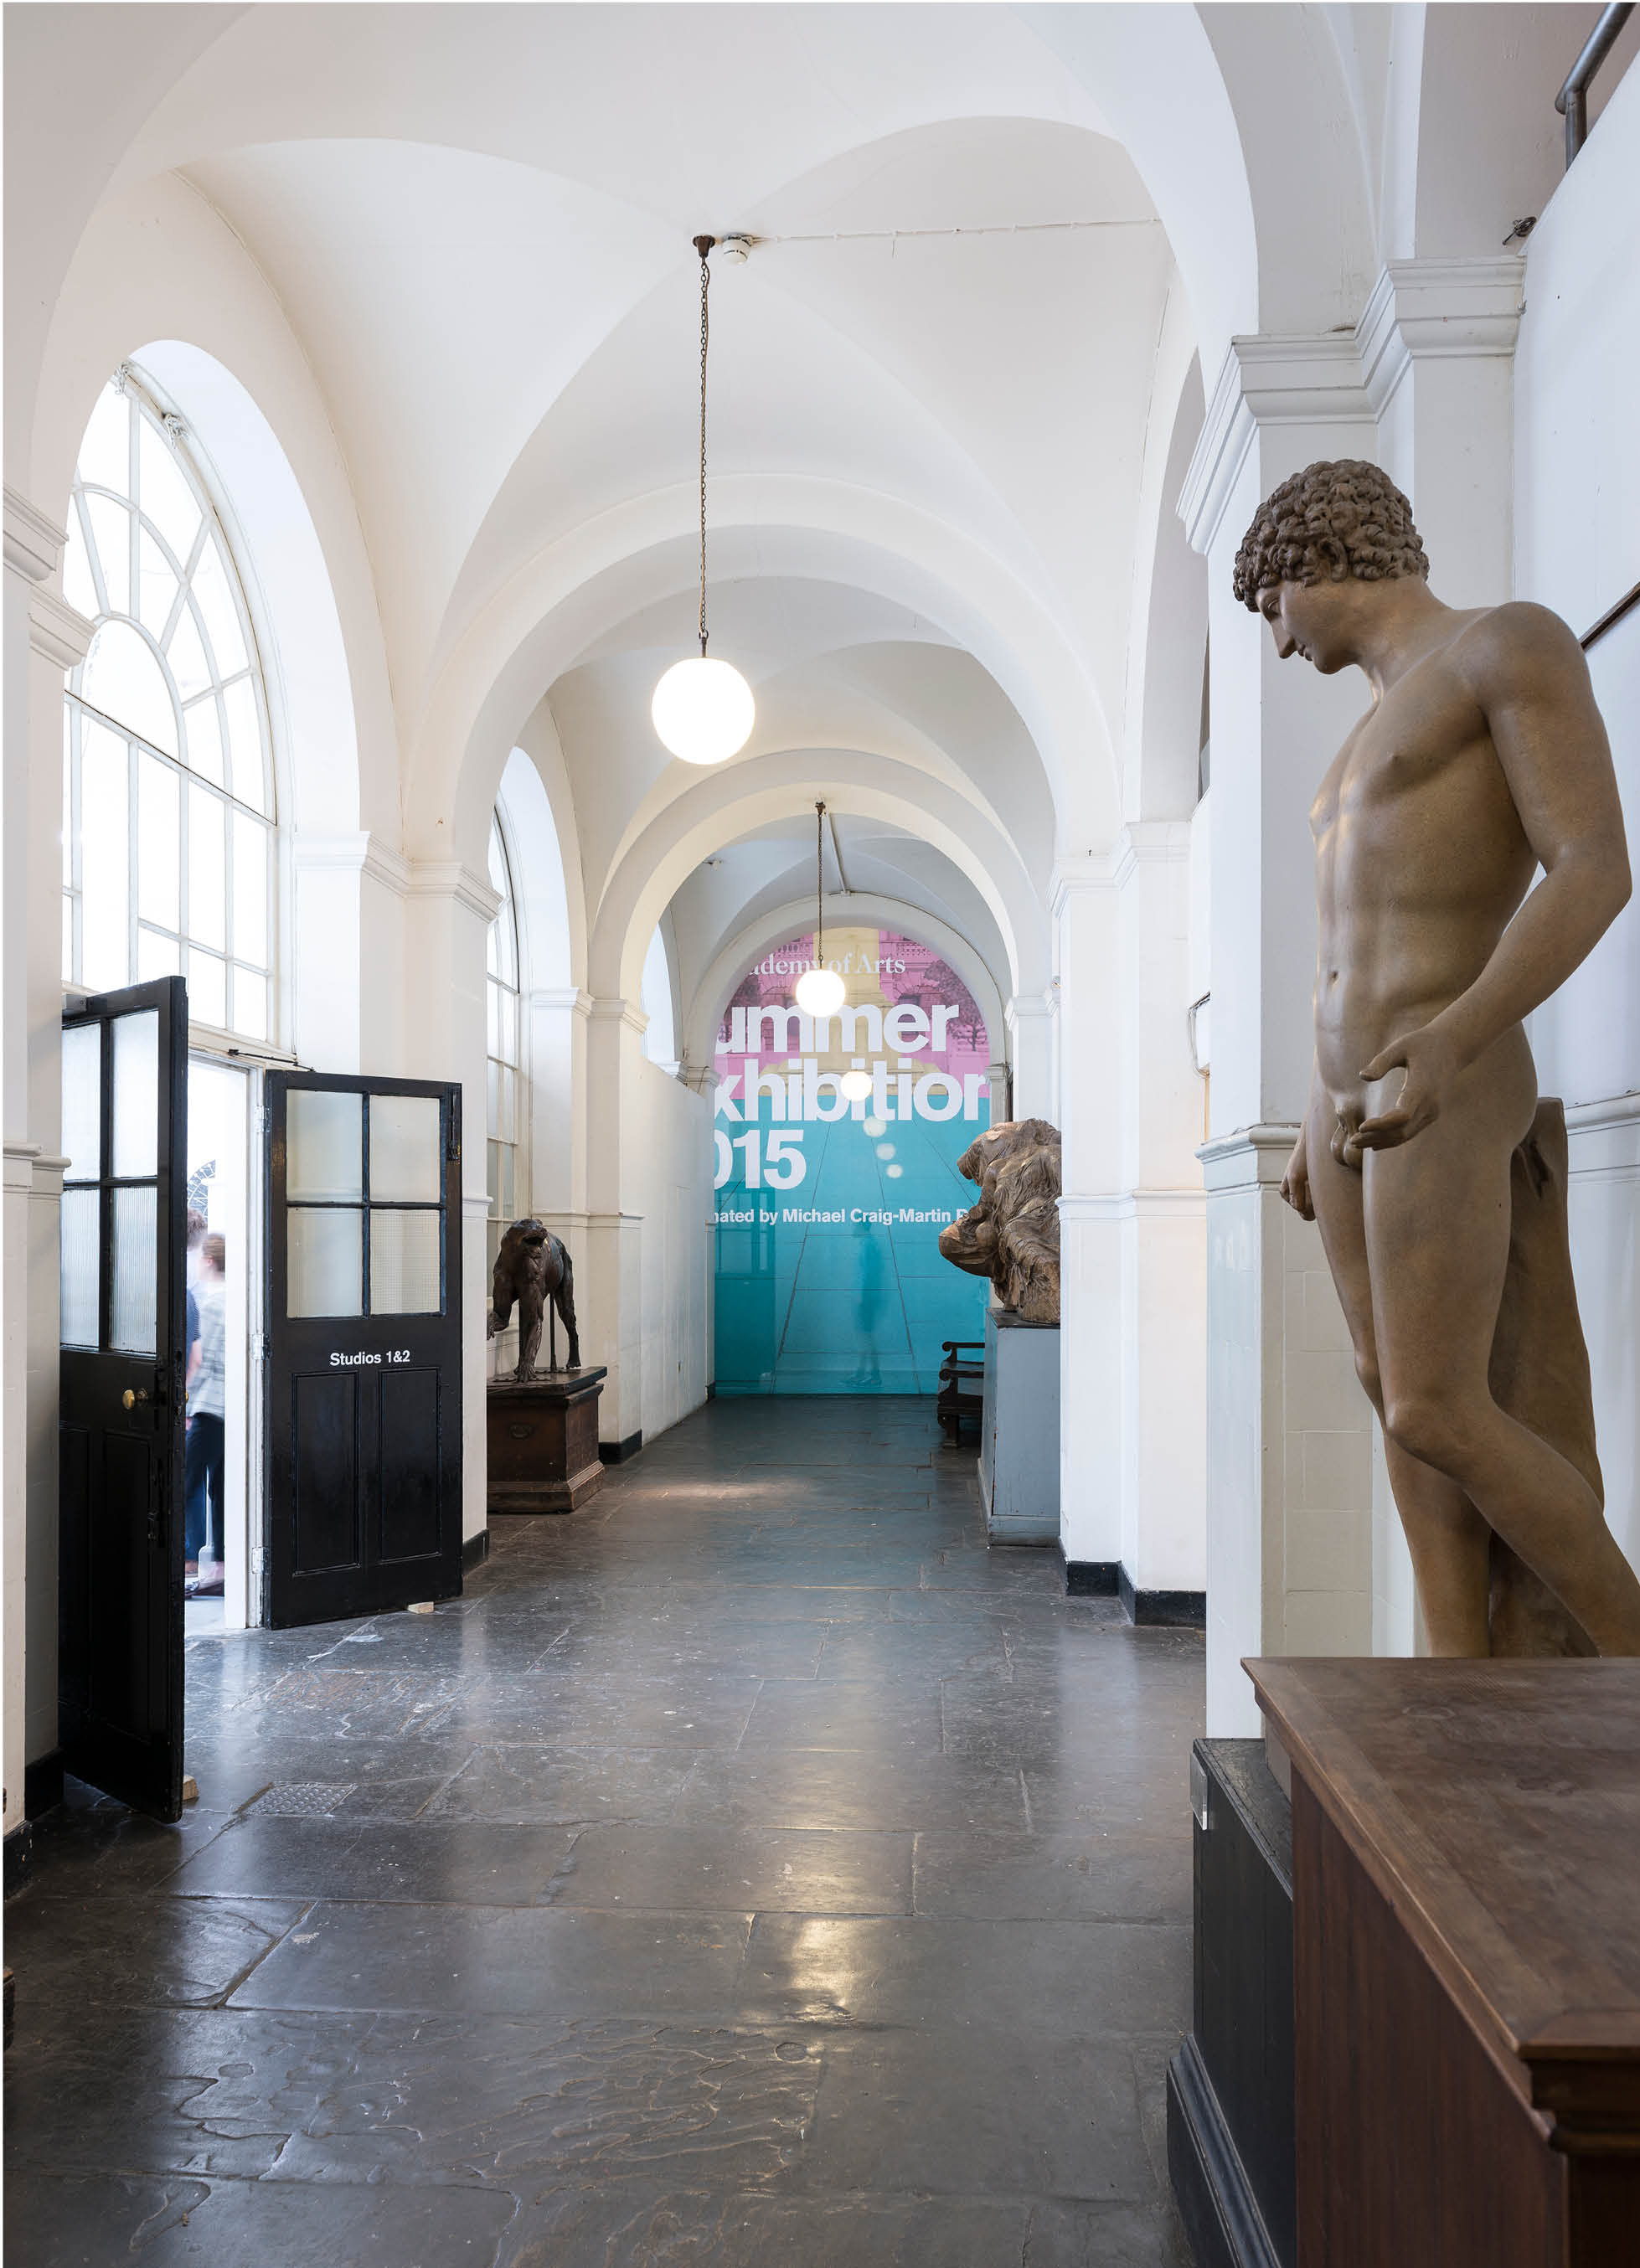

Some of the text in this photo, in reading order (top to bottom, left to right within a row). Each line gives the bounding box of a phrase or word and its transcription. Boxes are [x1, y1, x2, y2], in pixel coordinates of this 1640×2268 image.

[828, 951, 853, 975] of
[856, 952, 906, 975] Arts
[760, 1209, 778, 1225] by
[783, 1209, 845, 1223] Michael
[850, 1209, 952, 1225] Craig-Martin
[330, 1350, 410, 1366] Studios 1&2
